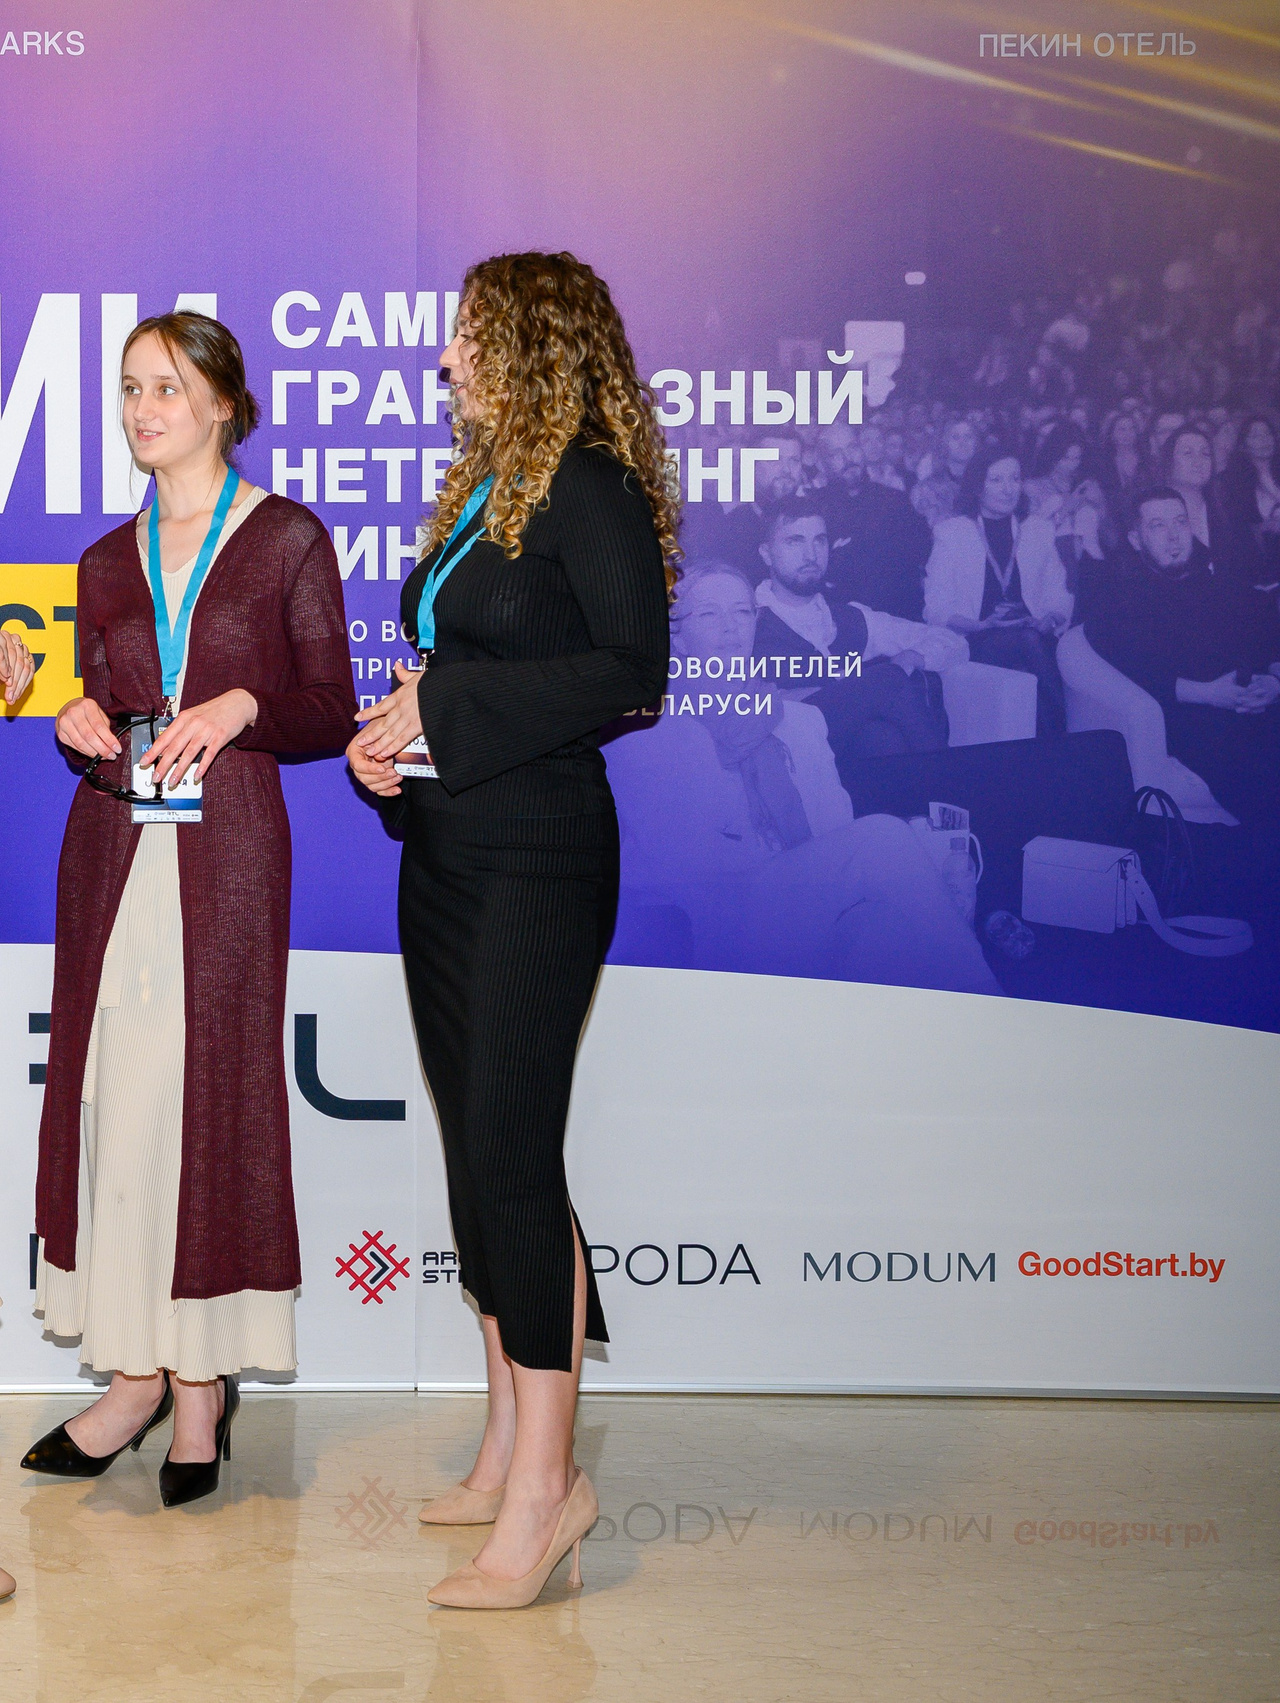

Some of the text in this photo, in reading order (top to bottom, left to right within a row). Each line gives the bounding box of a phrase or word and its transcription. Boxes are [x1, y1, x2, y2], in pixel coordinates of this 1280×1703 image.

[979, 32, 1197, 58] ПЕКИН ОТЕЛЬ
[271, 290, 460, 349] САМ
[667, 651, 862, 682] ОВОДИТЕЛЕЙ
[623, 693, 772, 716] ЛАРУСИ
[803, 1251, 996, 1282] MODUM
[1018, 1251, 1225, 1283] GoodStart.by
